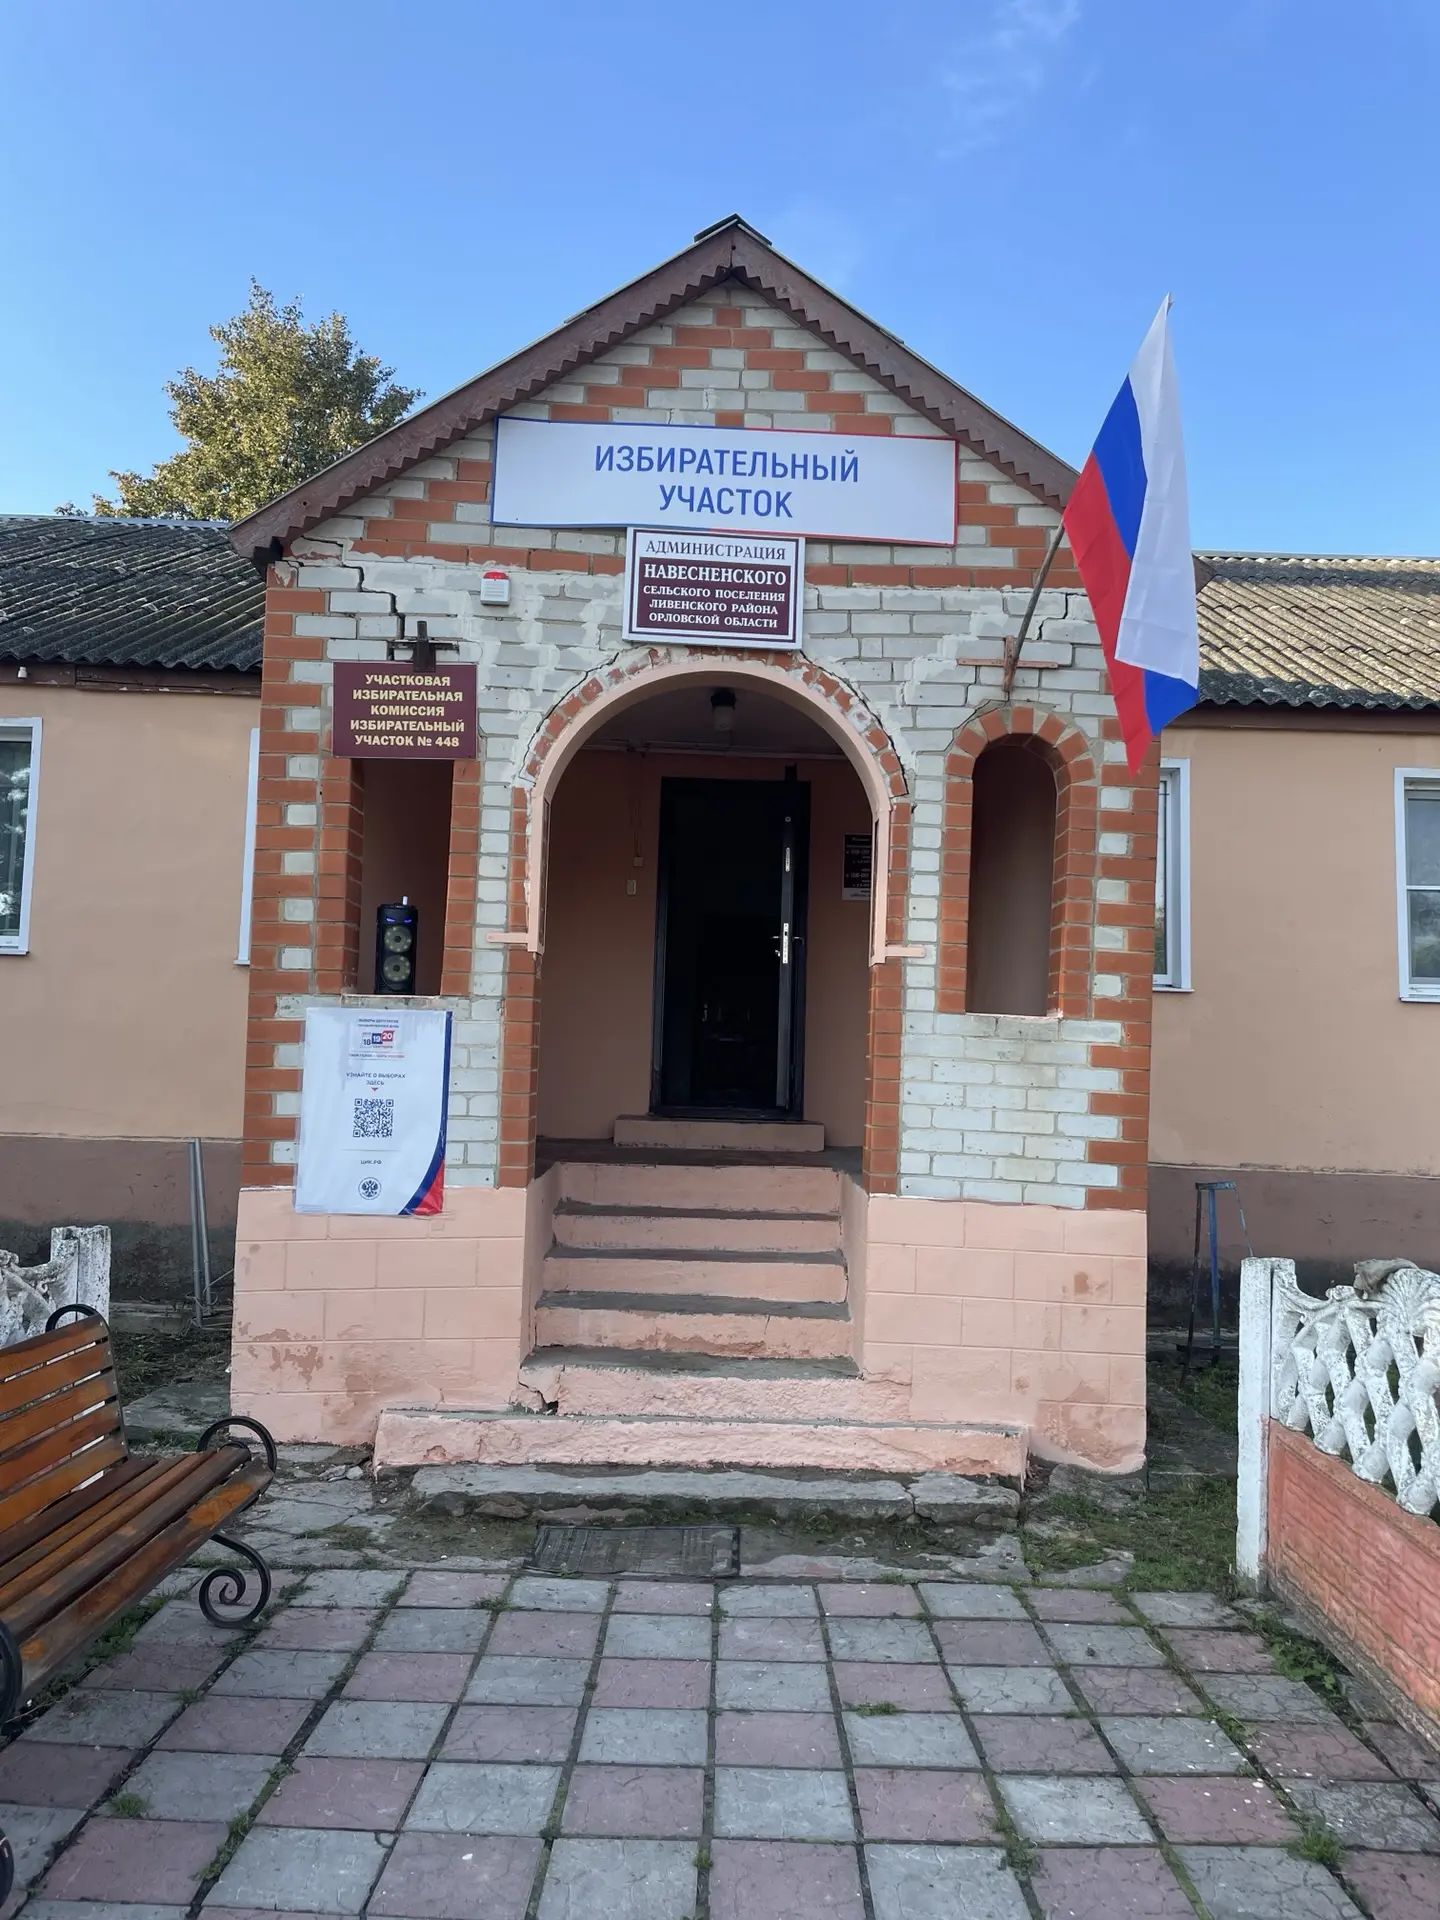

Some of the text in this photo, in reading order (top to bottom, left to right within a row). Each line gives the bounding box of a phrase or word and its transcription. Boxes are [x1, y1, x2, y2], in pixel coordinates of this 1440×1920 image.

[595, 445, 860, 483] ИЗБИРАТЕЛЬНЫЙ
[659, 484, 793, 519] УЧАСТОК
[645, 540, 786, 560] АДМИНИСТРАЦИЯ
[643, 563, 787, 586] НАВЕСНЕНСКОГО
[643, 585, 785, 602] СЕЛЬСКОГО ПОСЕЛЕНИЯ
[649, 599, 778, 615] ЛИВЕНСКОГО РАЙОНА
[649, 612, 778, 628] ОРЛОВСКОЙ ОБЛАСТИ
[365, 674, 451, 686] УЧАСТКОВАЯ
[352, 689, 463, 702] ИЗБИРАТЕЛЬНАЯ
[370, 705, 445, 716] КОМИССИЯ
[350, 719, 465, 732] ИЗБИРАТЕЛЬНЫЙ
[355, 735, 460, 747] УЧАСТОК № 448
[382, 1032, 393, 1040] 20
